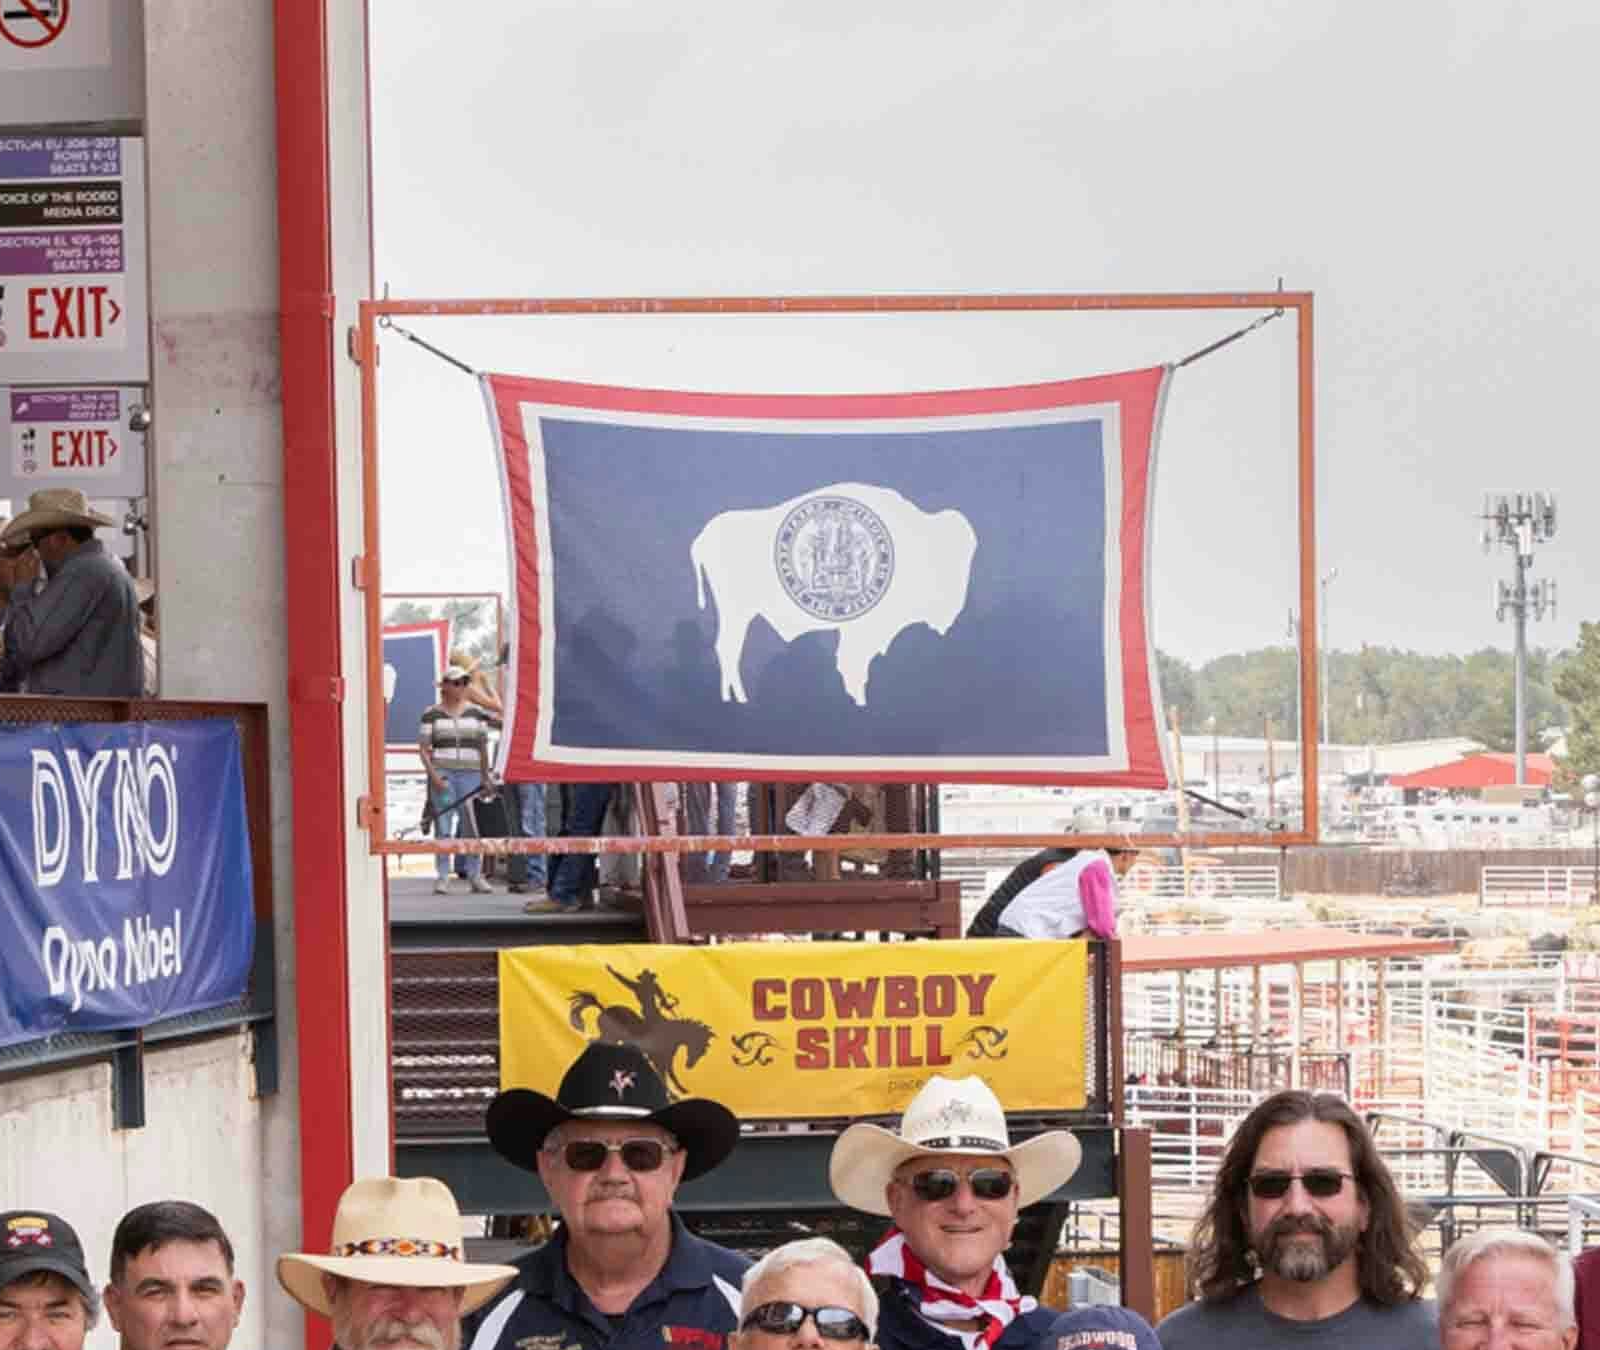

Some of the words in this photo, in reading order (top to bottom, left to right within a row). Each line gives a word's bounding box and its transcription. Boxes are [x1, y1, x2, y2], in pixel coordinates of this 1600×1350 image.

[32, 193, 49, 203] OF
[51, 192, 73, 203] THE
[76, 191, 118, 202] RODEO
[43, 206, 82, 217] MEDIA
[85, 206, 119, 216] DECK
[27, 286, 107, 339] EXIT
[51, 430, 108, 467] EXIT
[31, 743, 178, 886] DYNO
[43, 926, 117, 1012] Dyno
[125, 908, 182, 986] Nbel
[752, 973, 996, 1023] COWBOY
[794, 1025, 953, 1070] SKILL
